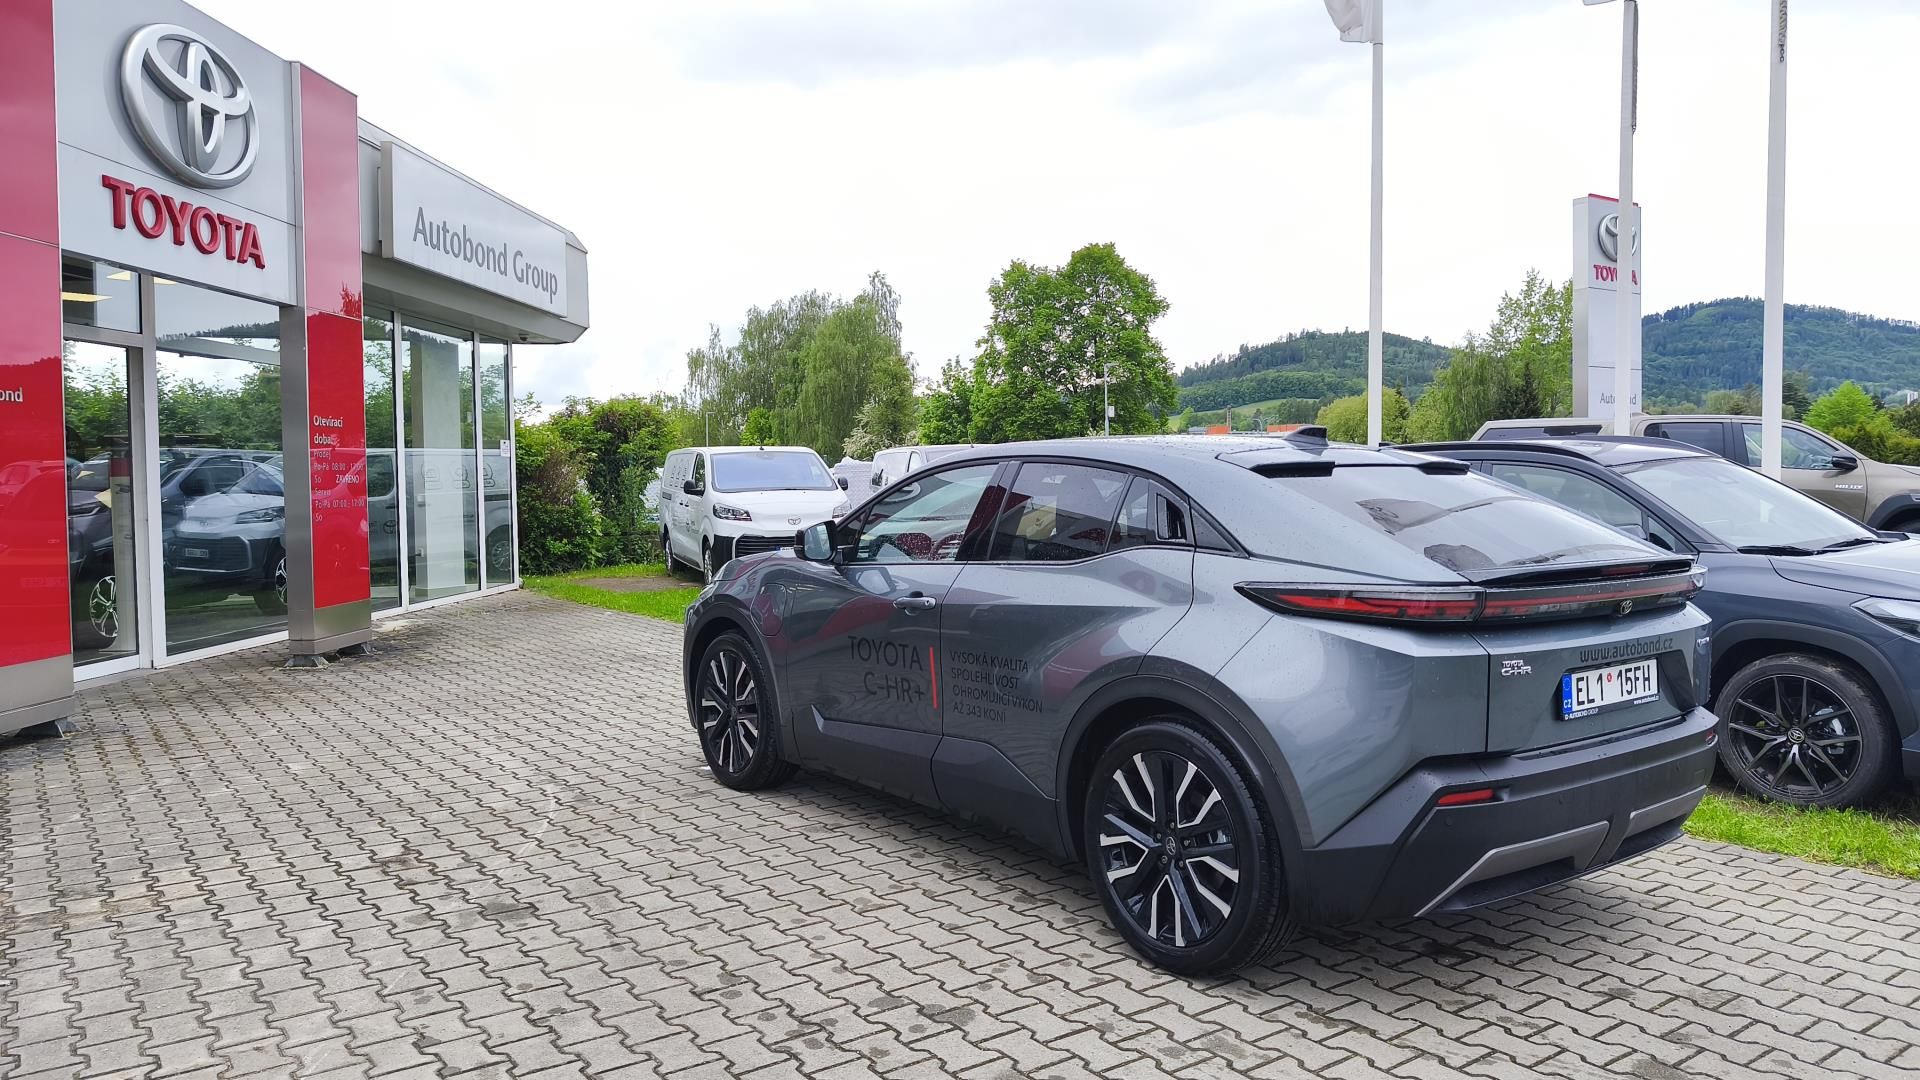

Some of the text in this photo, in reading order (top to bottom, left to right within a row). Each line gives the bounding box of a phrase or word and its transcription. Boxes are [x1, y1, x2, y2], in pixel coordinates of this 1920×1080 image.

[102, 174, 266, 270] TOYOTA
[412, 206, 559, 304] Autobond Group
[1593, 264, 1638, 286] TOYA
[847, 635, 922, 671] TOYOTA
[1579, 636, 1674, 663] www.autobond.cz
[990, 655, 1029, 673] KVALITA
[1502, 659, 1525, 668] TOYOTA
[863, 671, 926, 704] C-HR+
[951, 667, 1020, 689] SPOLEHLIVOST
[1616, 664, 1652, 698] 15FH
[966, 703, 982, 718] 343
[1563, 699, 1572, 709] CZ
